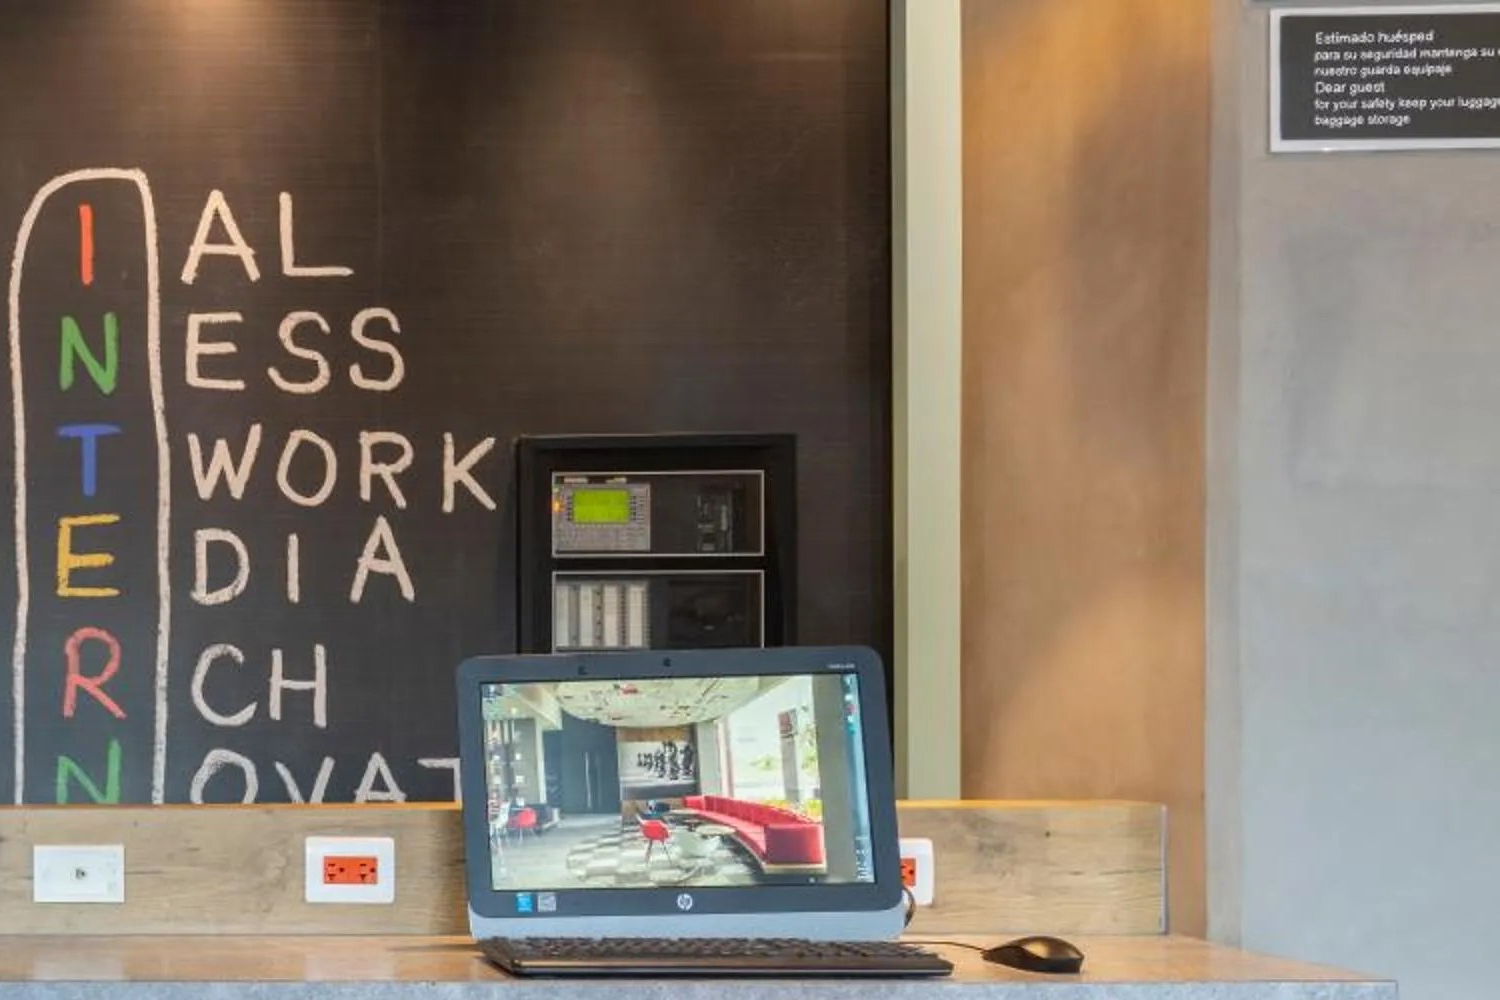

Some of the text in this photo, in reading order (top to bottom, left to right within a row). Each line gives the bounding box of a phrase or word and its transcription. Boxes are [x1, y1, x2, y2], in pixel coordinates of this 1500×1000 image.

[1315, 28, 1435, 45] Estimado huésped
[1314, 51, 1340, 62] para
[1343, 51, 1357, 60] su
[1360, 48, 1417, 62] seguridad
[1419, 47, 1478, 60] mantenga
[1480, 48, 1495, 57] su
[1314, 62, 1453, 78] nuestro guarda equipaje
[1315, 81, 1385, 96] Dear guest
[1314, 95, 1500, 112] for your safety keep your luggag
[1315, 114, 1411, 128] baggage storage
